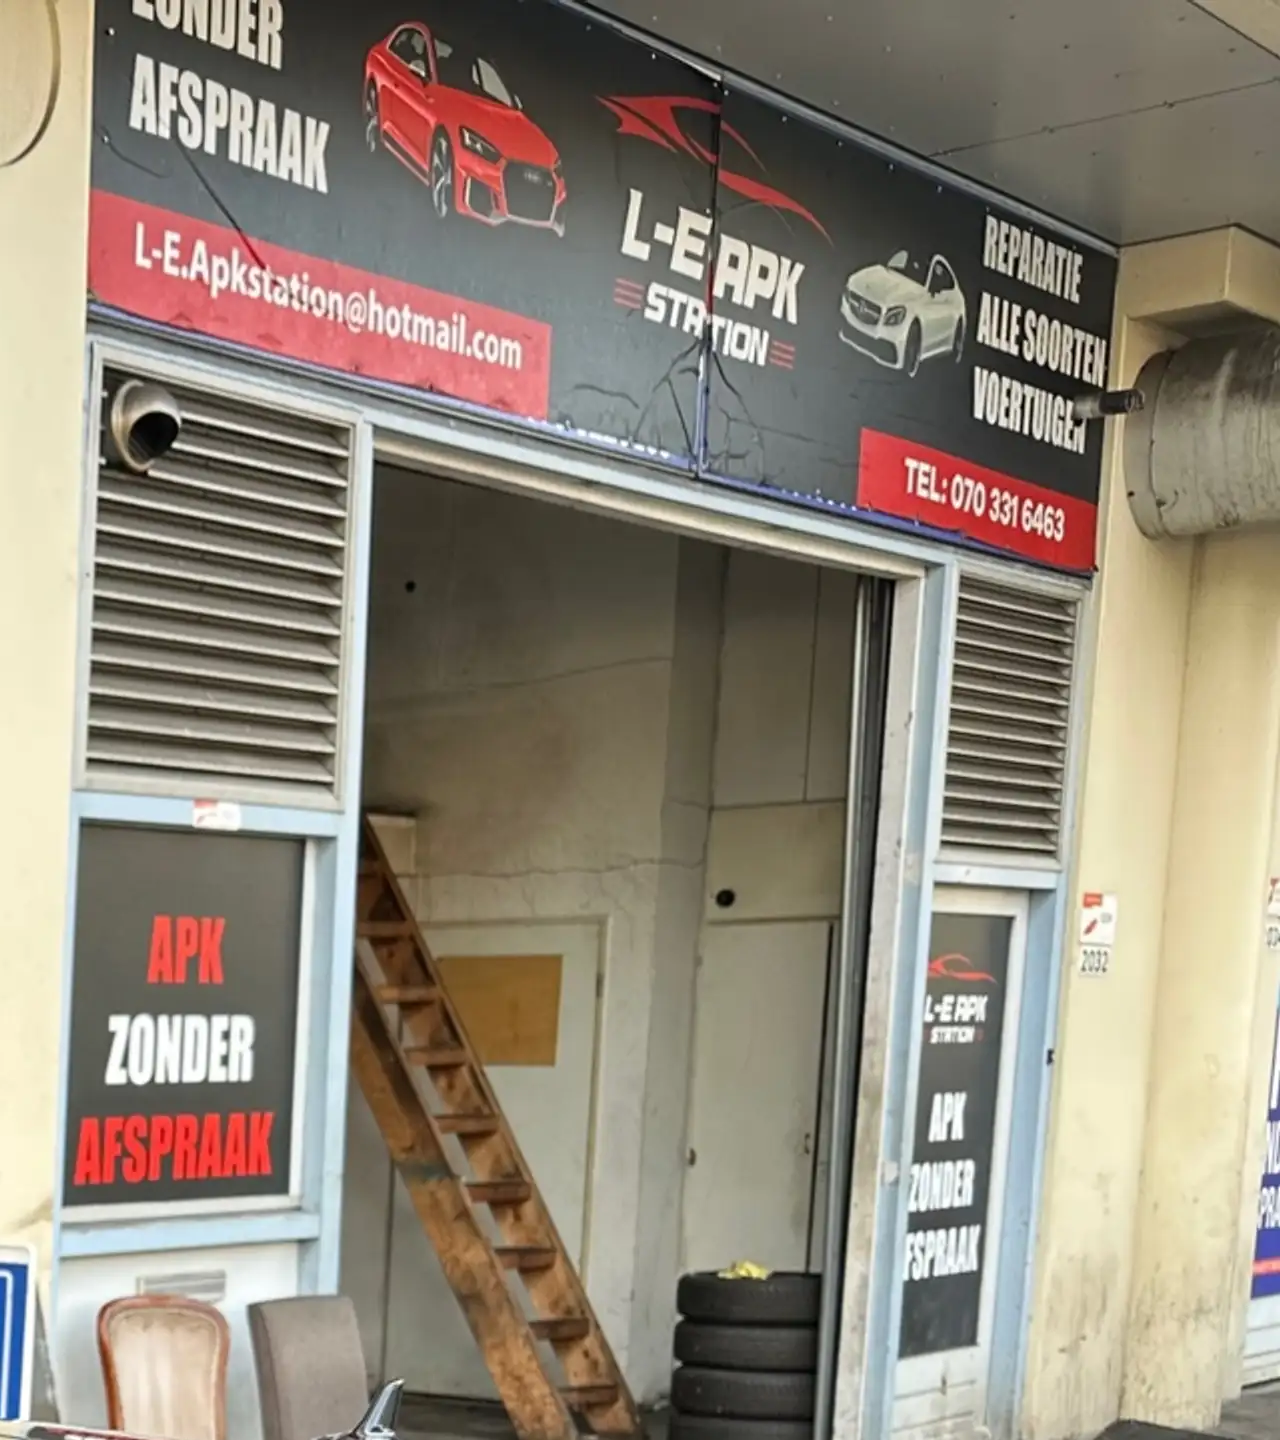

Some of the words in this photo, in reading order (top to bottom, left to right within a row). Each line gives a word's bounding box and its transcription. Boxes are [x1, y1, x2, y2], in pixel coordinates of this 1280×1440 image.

[129, 53, 330, 194] AFSPRAAK
[135, 222, 522, 371] L-E.Apkstation@hotmail.com
[713, 232, 806, 326] APK
[983, 214, 1084, 304] REPARATIE
[643, 282, 770, 367] STATION
[976, 291, 1022, 357] ALLE
[1022, 306, 1108, 389] SOORTEN
[905, 457, 947, 503] TEL:
[949, 474, 984, 518] 070
[989, 487, 1020, 527] 331
[1021, 497, 1066, 543] 6463
[146, 914, 226, 986] APK
[104, 1013, 255, 1086] ZONDER
[73, 1111, 274, 1186] AFSPRAAK
[928, 1090, 967, 1143] APK
[908, 1157, 976, 1214] ZONDER
[902, 1224, 982, 1282] FSPRAAK
